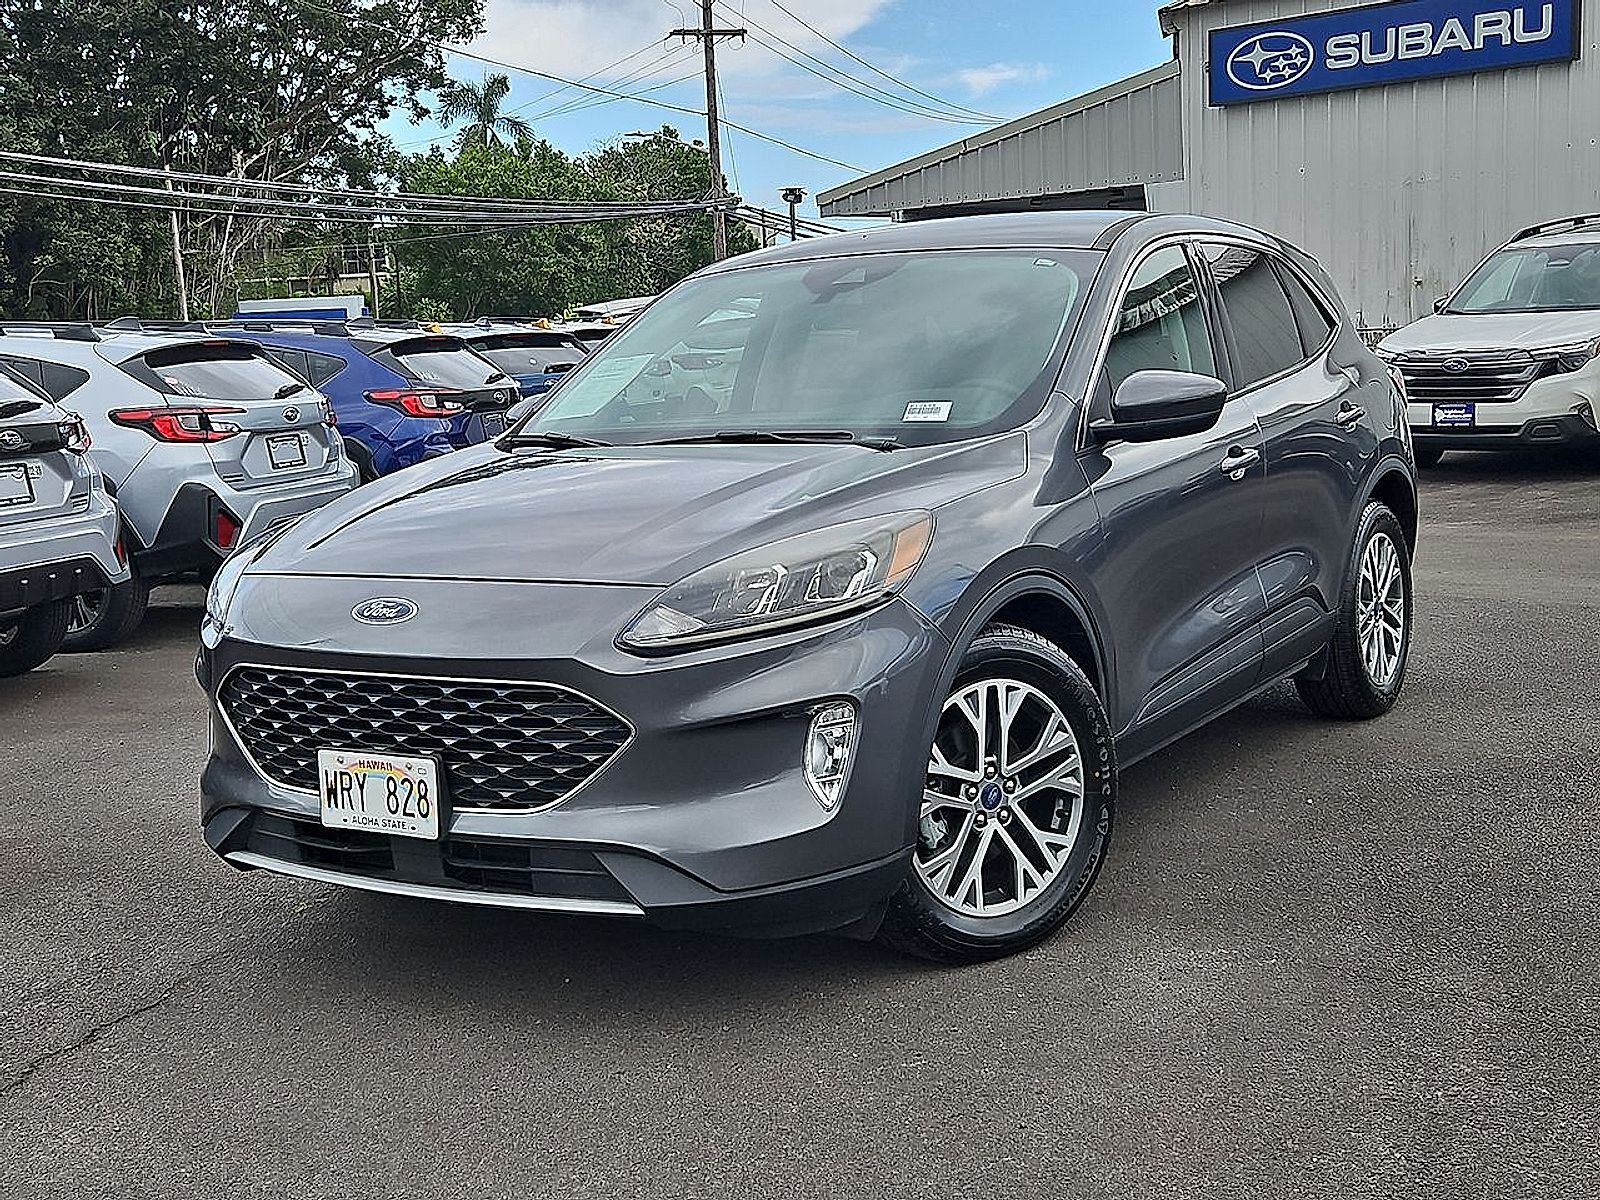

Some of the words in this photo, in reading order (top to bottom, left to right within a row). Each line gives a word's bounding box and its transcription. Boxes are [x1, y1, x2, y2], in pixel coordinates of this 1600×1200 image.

[1325, 3, 1553, 70] SUBARU
[363, 601, 403, 619] Ford
[358, 759, 394, 772] HAWAII
[324, 769, 367, 813] WRY
[386, 775, 430, 819] 828
[351, 815, 380, 827] ALOHA
[381, 818, 407, 830] STATE
